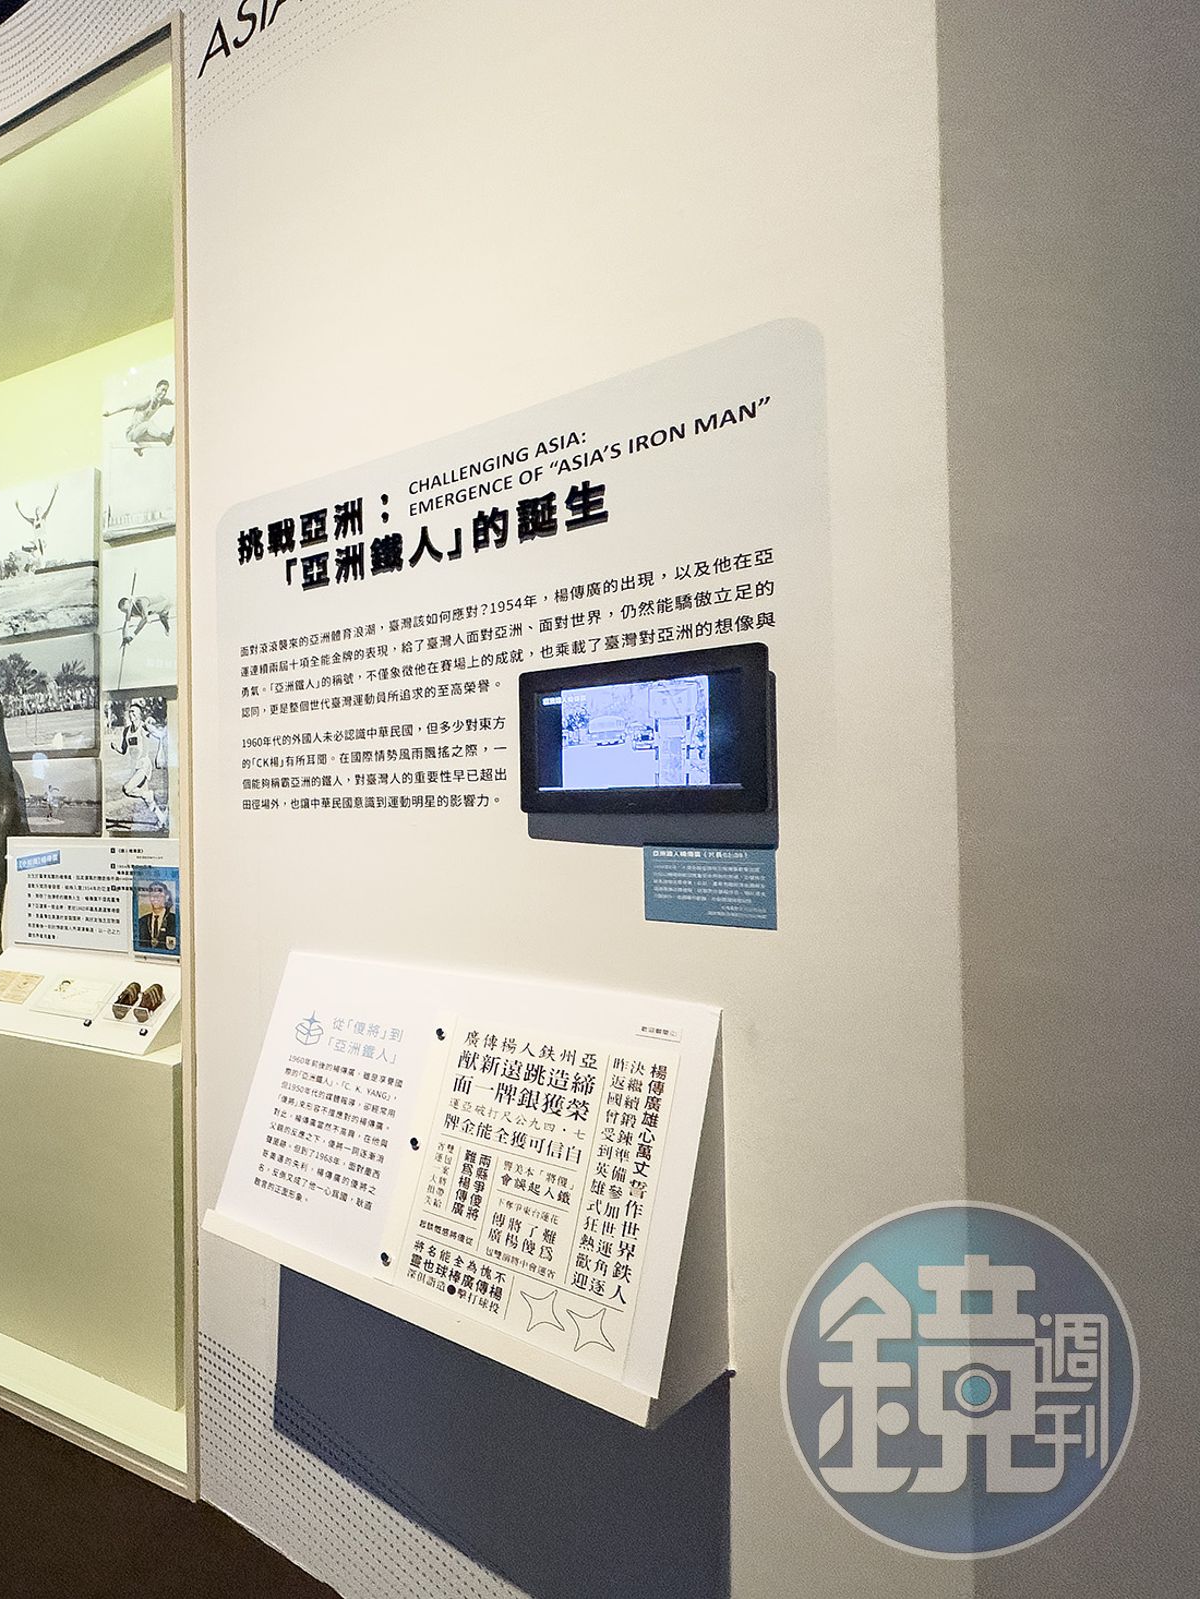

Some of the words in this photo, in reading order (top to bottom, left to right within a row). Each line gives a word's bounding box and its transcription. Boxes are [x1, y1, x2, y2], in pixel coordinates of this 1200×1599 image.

[408, 447, 530, 496] CHALLENGING
[535, 431, 587, 458] ASIA:
[409, 475, 513, 517] EMERGENCE
[518, 466, 545, 486] OF
[549, 443, 622, 476] “ASIA’S
[628, 422, 686, 455] IRON
[694, 395, 771, 435] MAN”
[237, 493, 390, 565] 挑戰亞洲：
[285, 480, 609, 591] 「亞洲鐵人」的誕生
